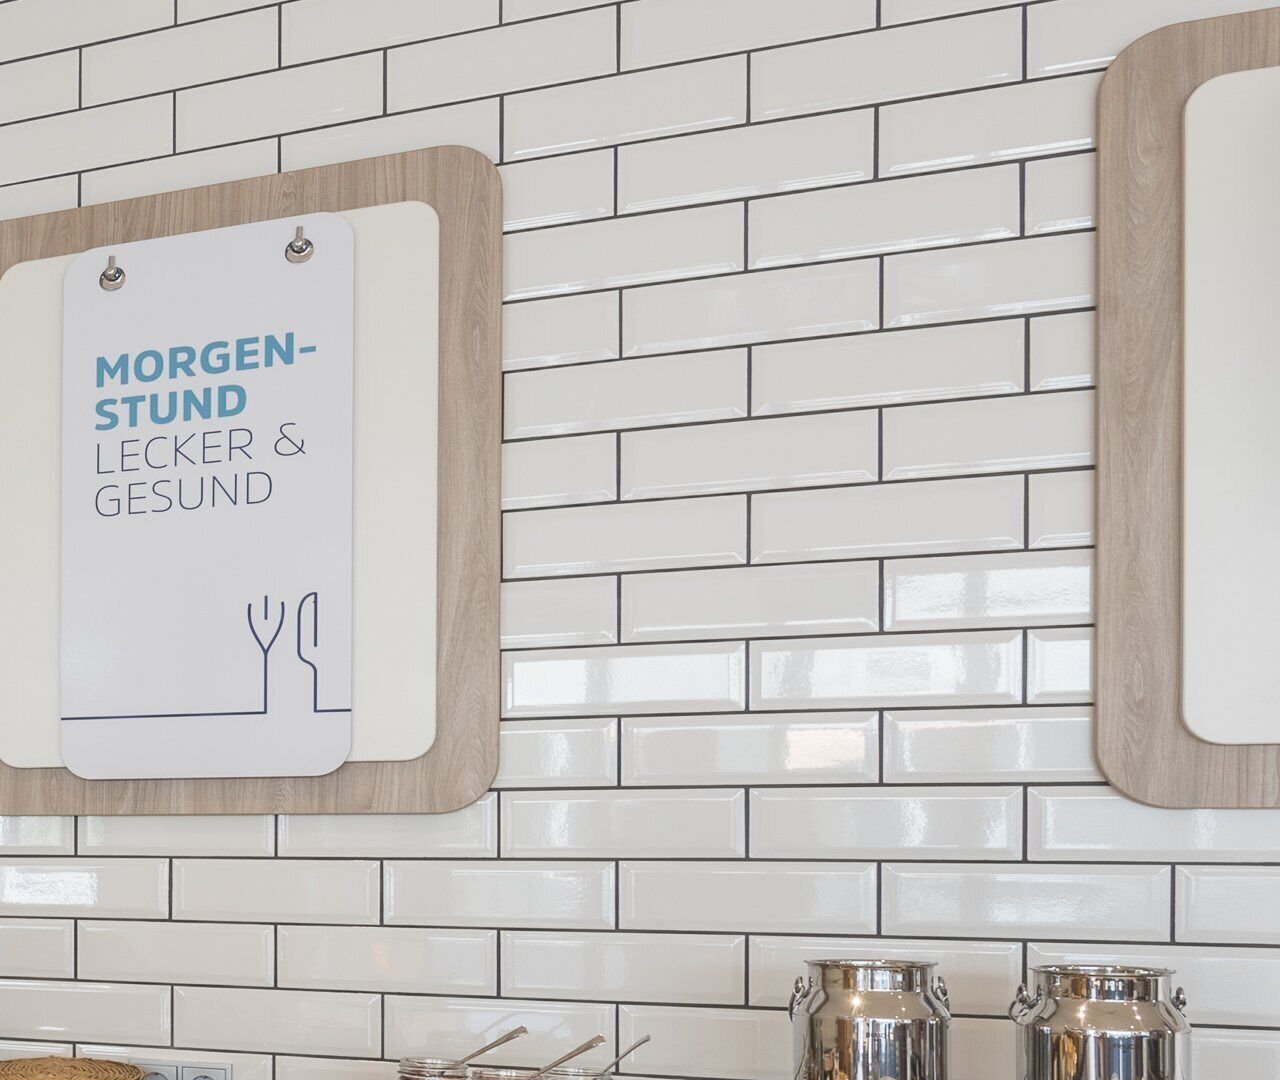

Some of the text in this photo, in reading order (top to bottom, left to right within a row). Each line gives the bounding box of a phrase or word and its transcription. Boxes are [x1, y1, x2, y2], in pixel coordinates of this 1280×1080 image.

[95, 331, 317, 388] MORGEN-
[94, 384, 248, 431] STUND
[96, 422, 306, 475] LECKER &
[94, 471, 273, 517] GESUND
